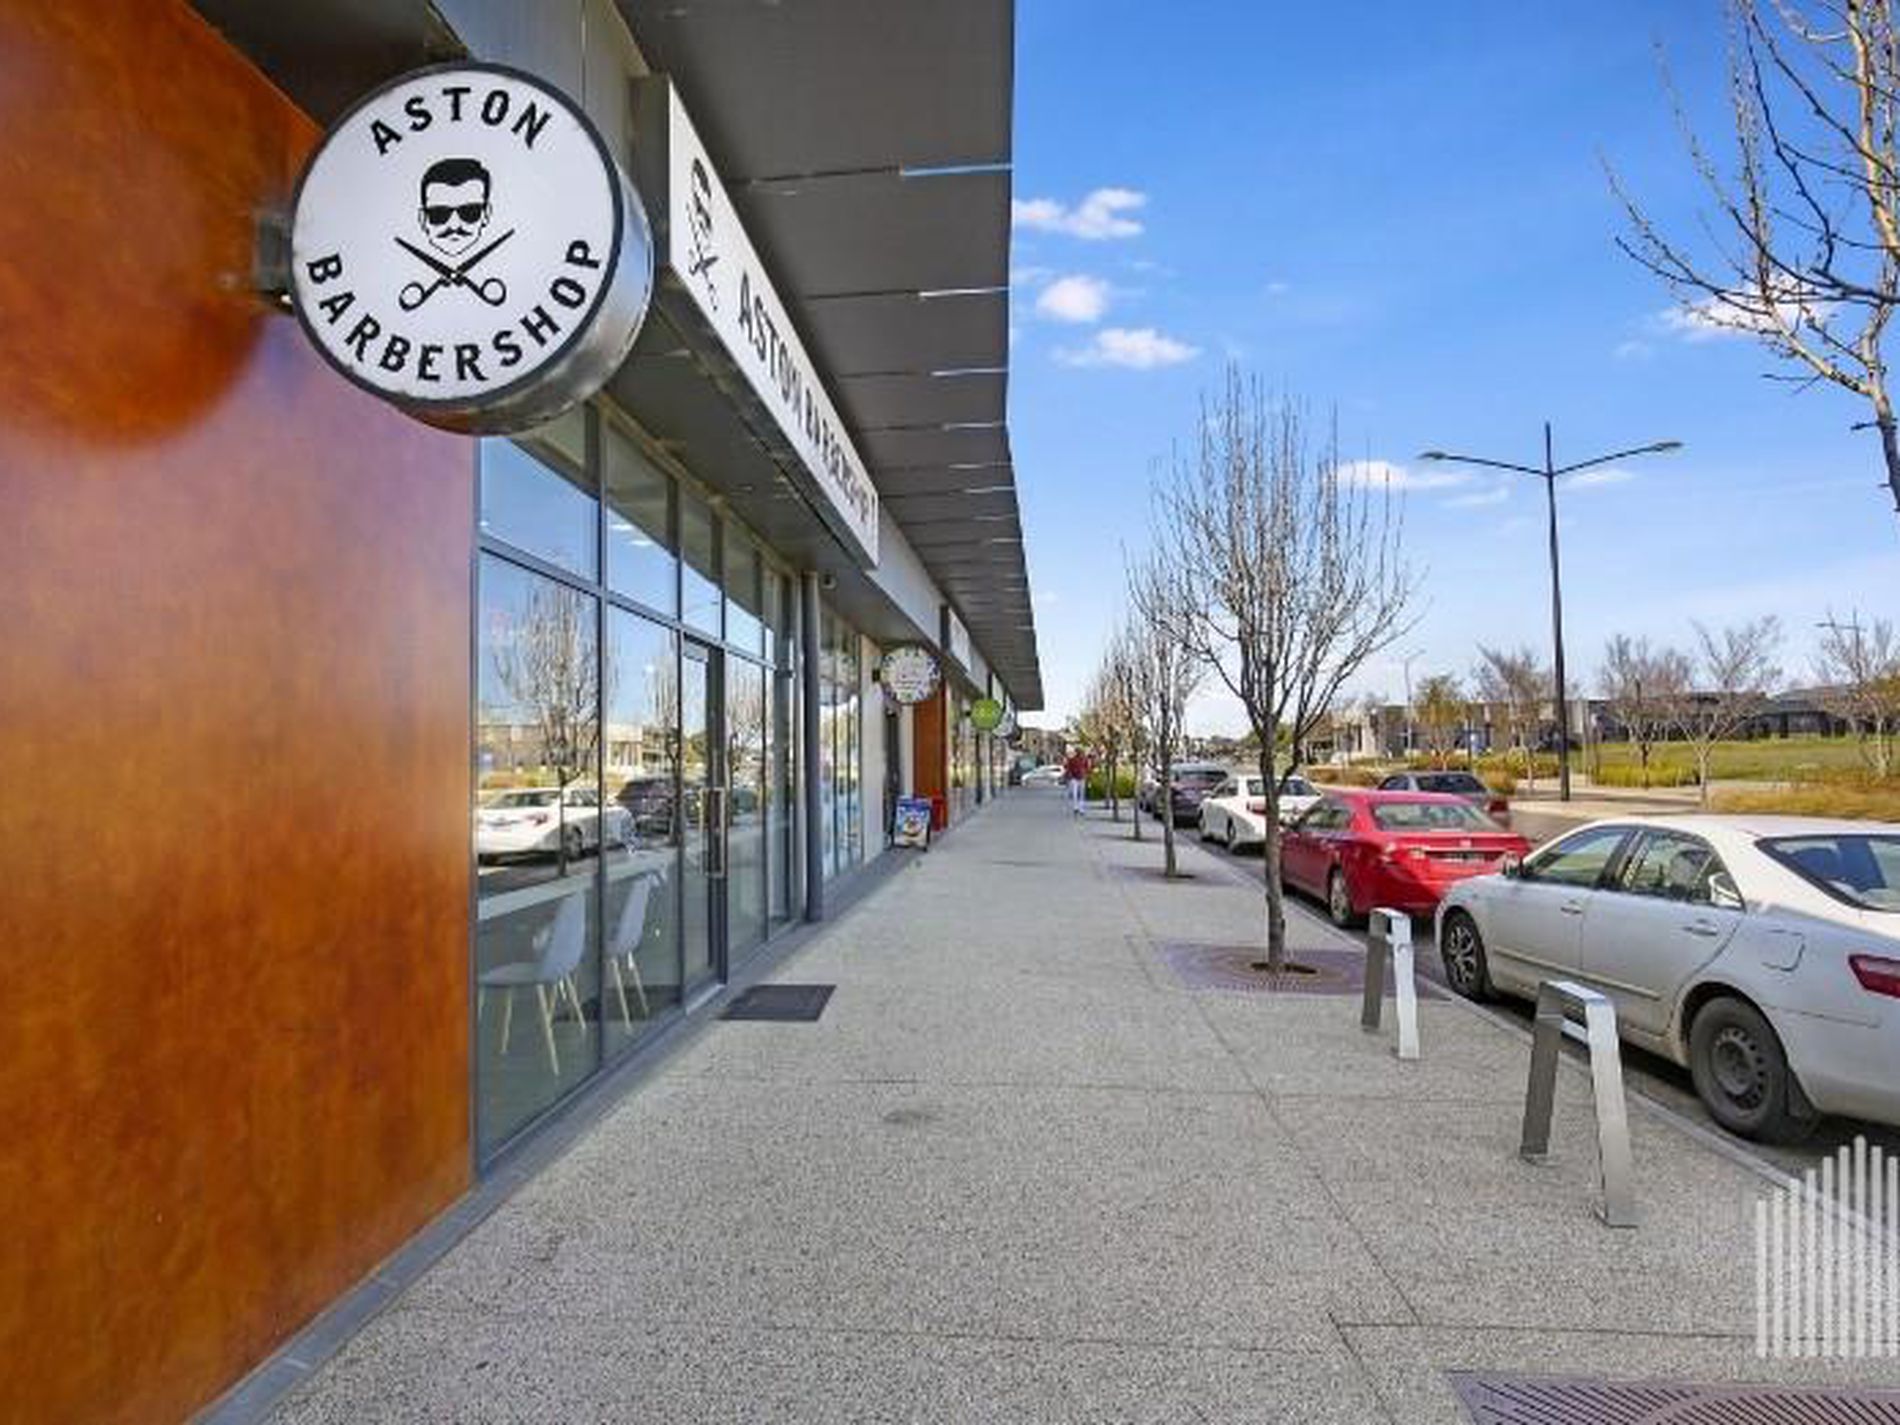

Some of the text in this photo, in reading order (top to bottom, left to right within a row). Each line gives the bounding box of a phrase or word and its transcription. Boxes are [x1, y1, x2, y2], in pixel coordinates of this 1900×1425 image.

[370, 86, 552, 156] ASTON
[306, 239, 602, 382] BARBERSHOP
[739, 271, 803, 428] ASTON
